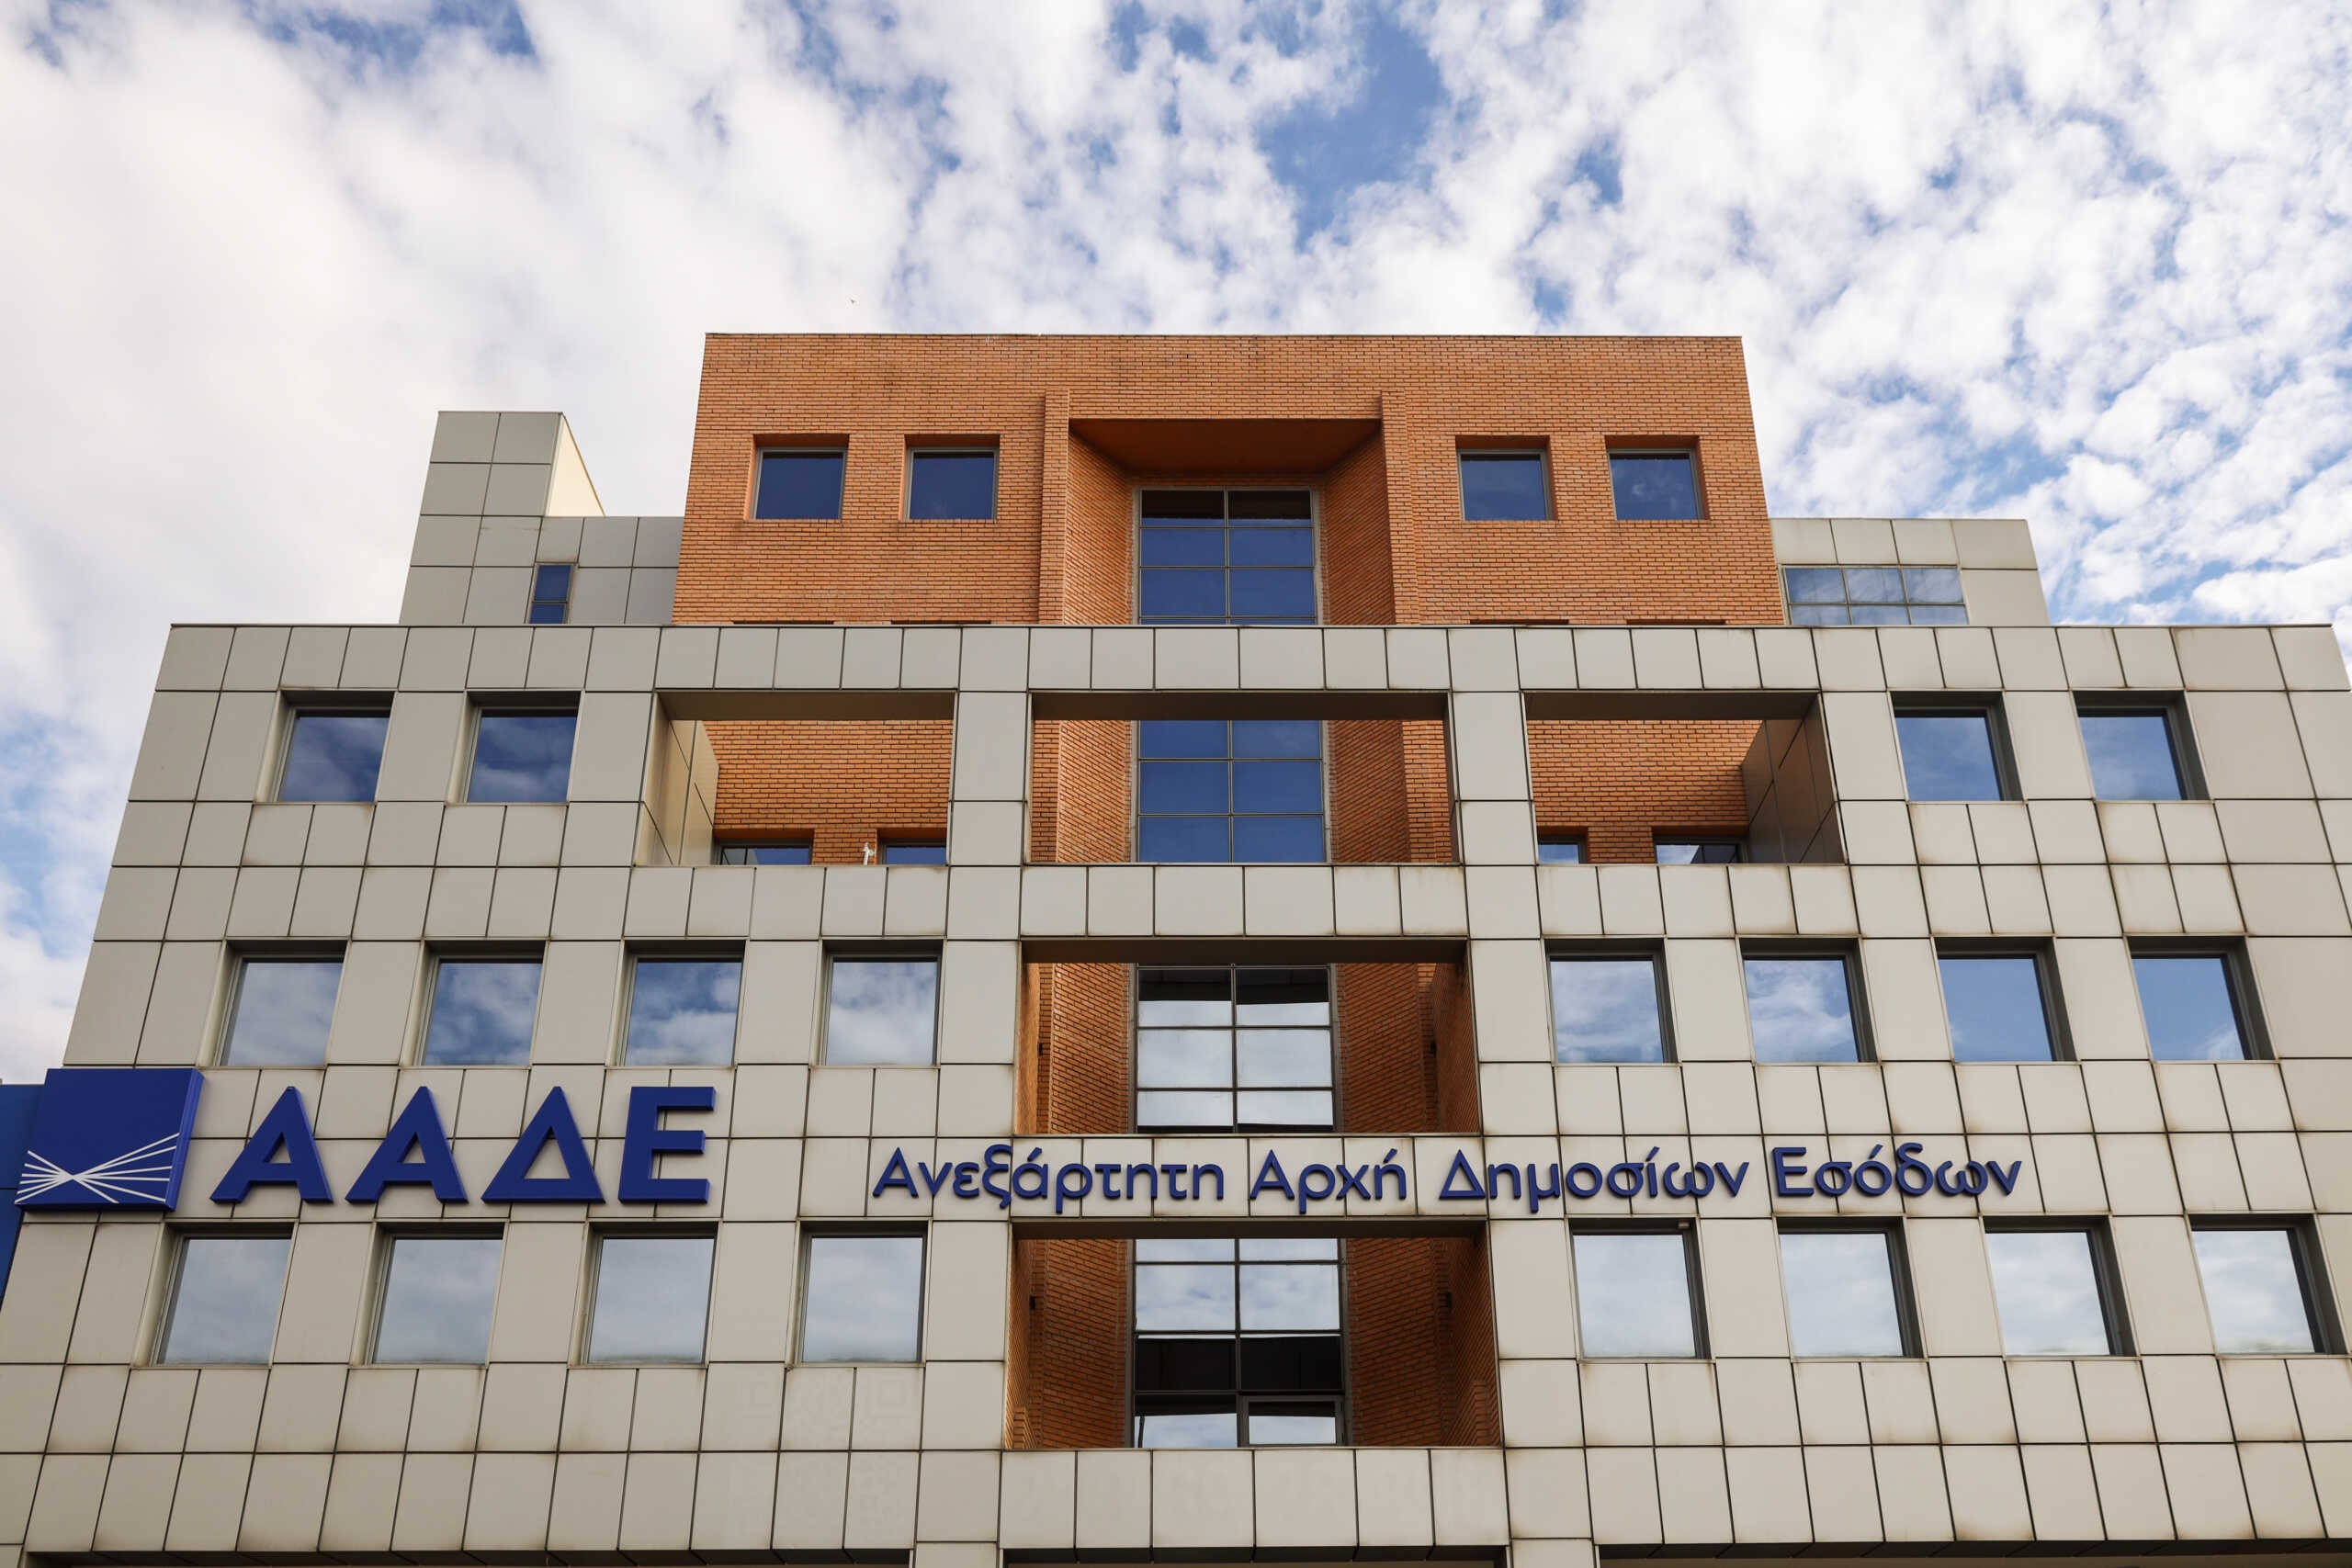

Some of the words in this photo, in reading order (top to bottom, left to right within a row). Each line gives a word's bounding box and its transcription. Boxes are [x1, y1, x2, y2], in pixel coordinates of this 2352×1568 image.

[209, 1086, 716, 1203] ΑΑΔΕ
[872, 1145, 1225, 1214] Ανεξάρτητη
[1250, 1148, 1407, 1214] Αρχή
[1439, 1146, 1749, 1213] Δημοσίων
[1772, 1143, 2021, 1197] Εσόδων
